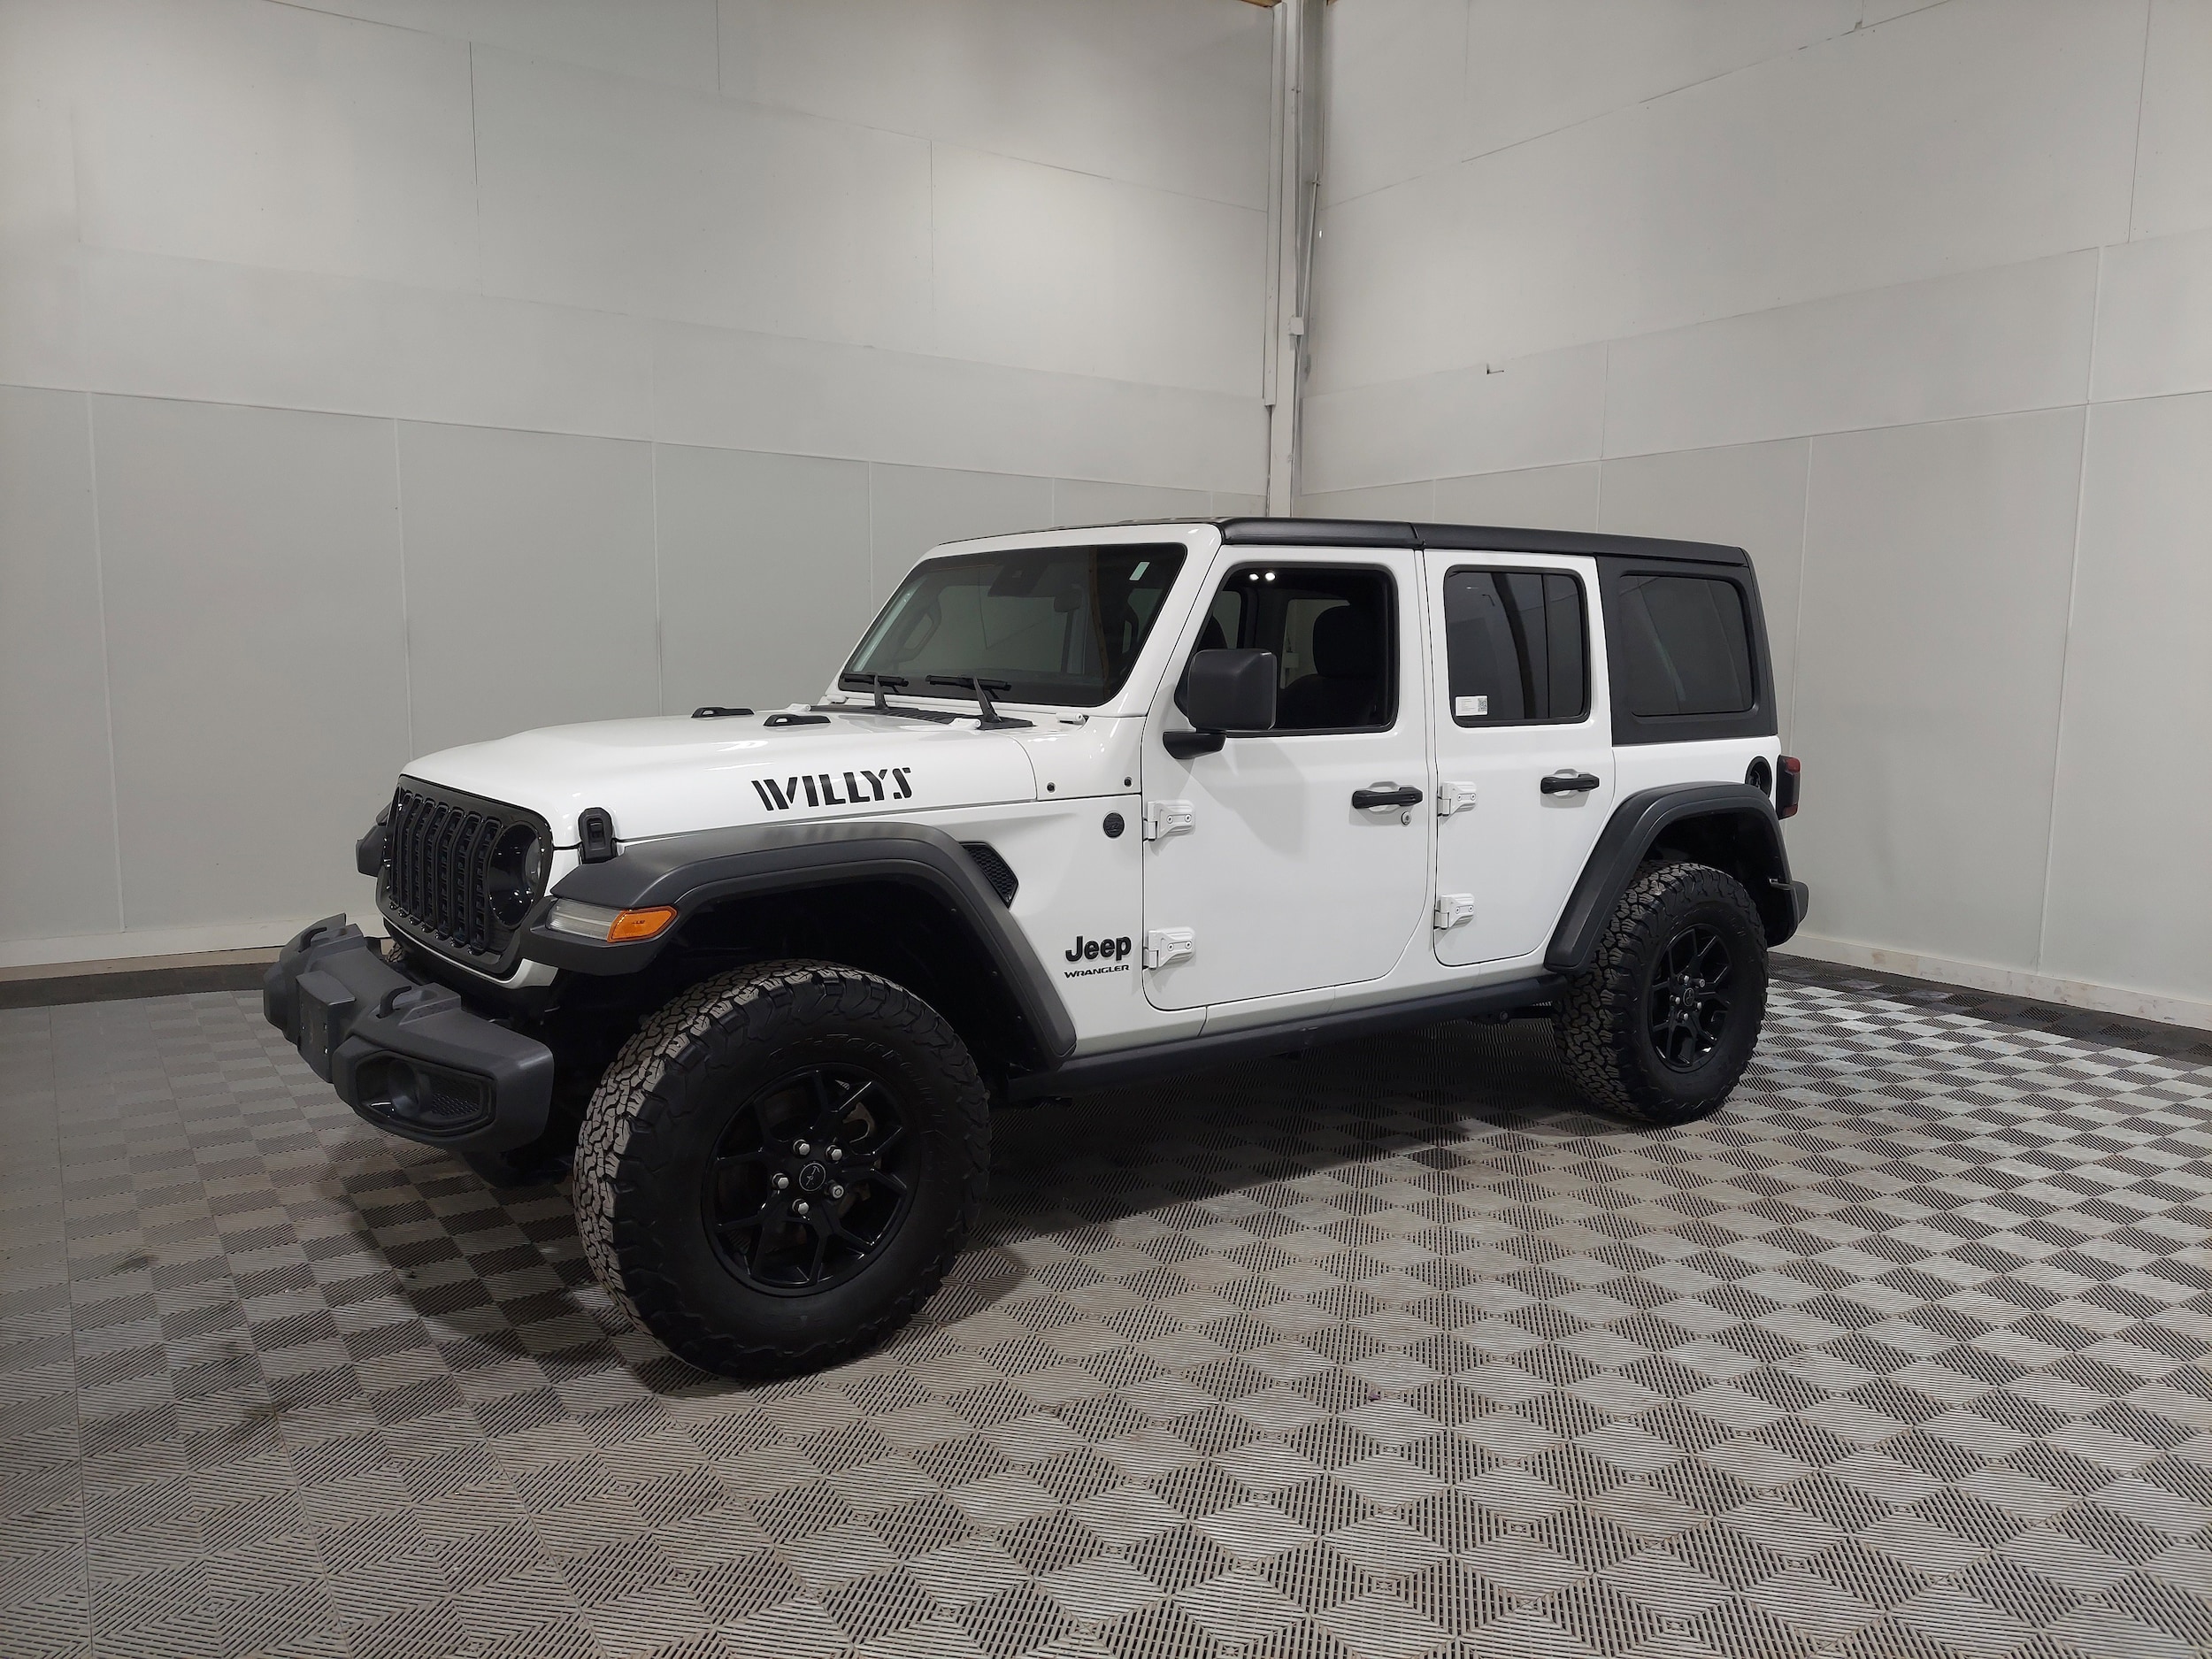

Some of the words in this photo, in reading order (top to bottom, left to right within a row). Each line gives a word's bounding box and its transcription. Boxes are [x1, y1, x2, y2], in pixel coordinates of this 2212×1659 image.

[751, 767, 912, 811] WILLYS
[1064, 935, 1132, 962] Jeep
[1064, 964, 1130, 979] WRANGLER
